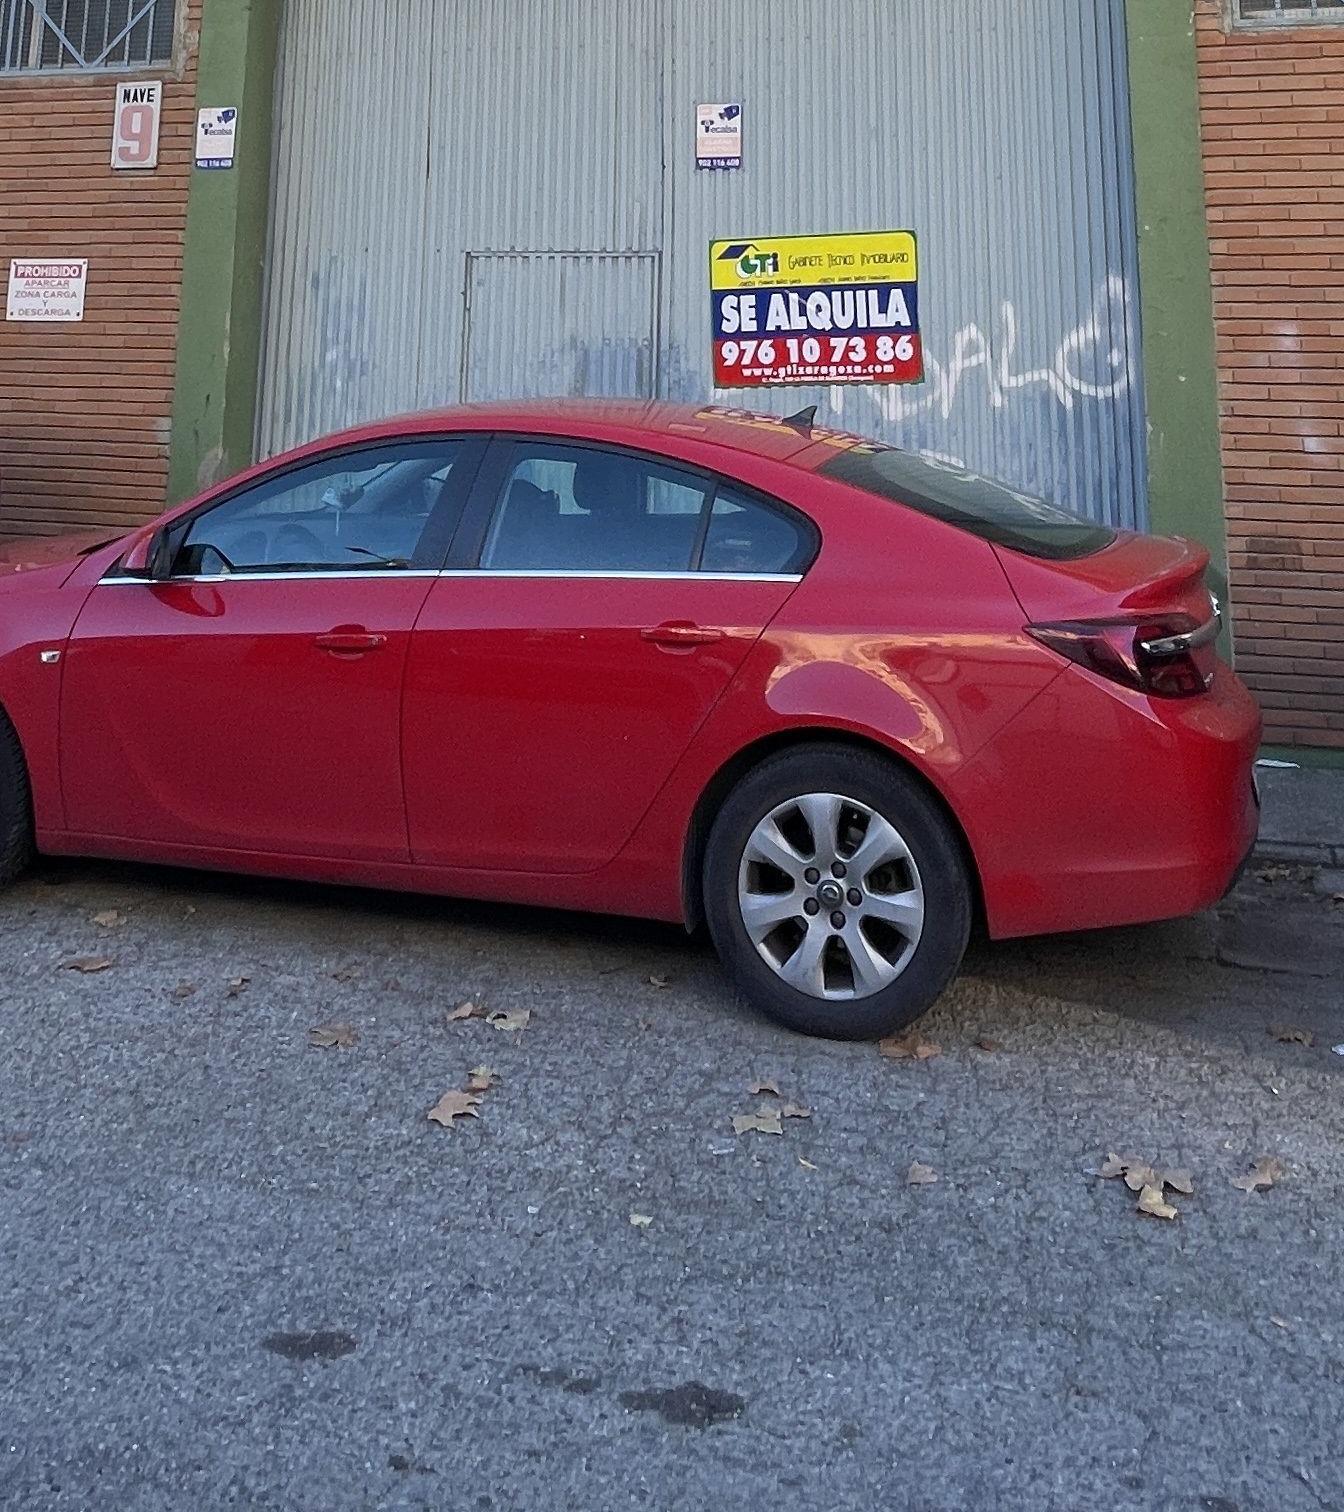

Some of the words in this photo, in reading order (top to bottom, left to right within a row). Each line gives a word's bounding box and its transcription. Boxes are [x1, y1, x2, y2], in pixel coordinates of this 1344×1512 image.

[123, 87, 155, 103] NAVE
[118, 104, 153, 161] 9
[17, 266, 79, 277] PROHIBIDO
[24, 279, 70, 287] APARCAR
[721, 294, 757, 333] SE
[765, 288, 911, 331] ALQUILA
[721, 339, 776, 367] 976
[786, 337, 821, 363] 10
[830, 336, 867, 362] 73
[875, 334, 914, 362] 86
